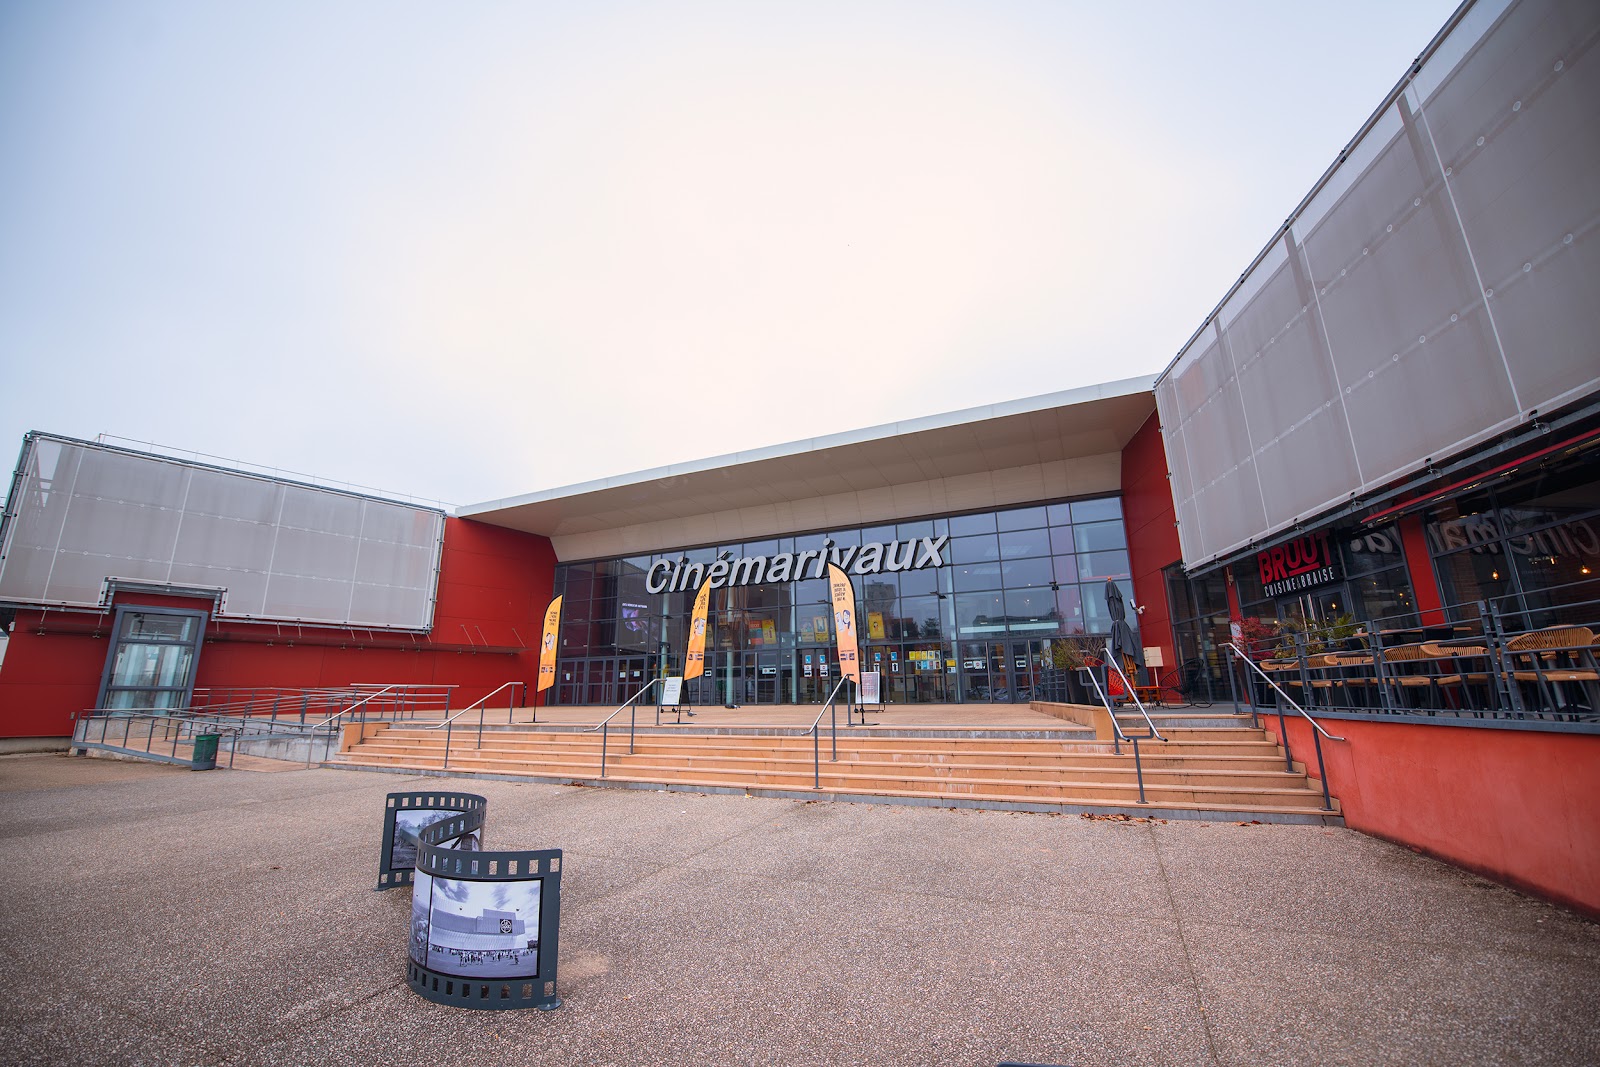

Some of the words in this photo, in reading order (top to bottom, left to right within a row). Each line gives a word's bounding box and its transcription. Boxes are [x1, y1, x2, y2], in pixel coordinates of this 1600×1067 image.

[645, 534, 949, 594] Cinémarivaux
[1257, 530, 1331, 584] BRUUT
[1264, 578, 1296, 597] CUISINE
[1301, 567, 1334, 587] BRAISE
